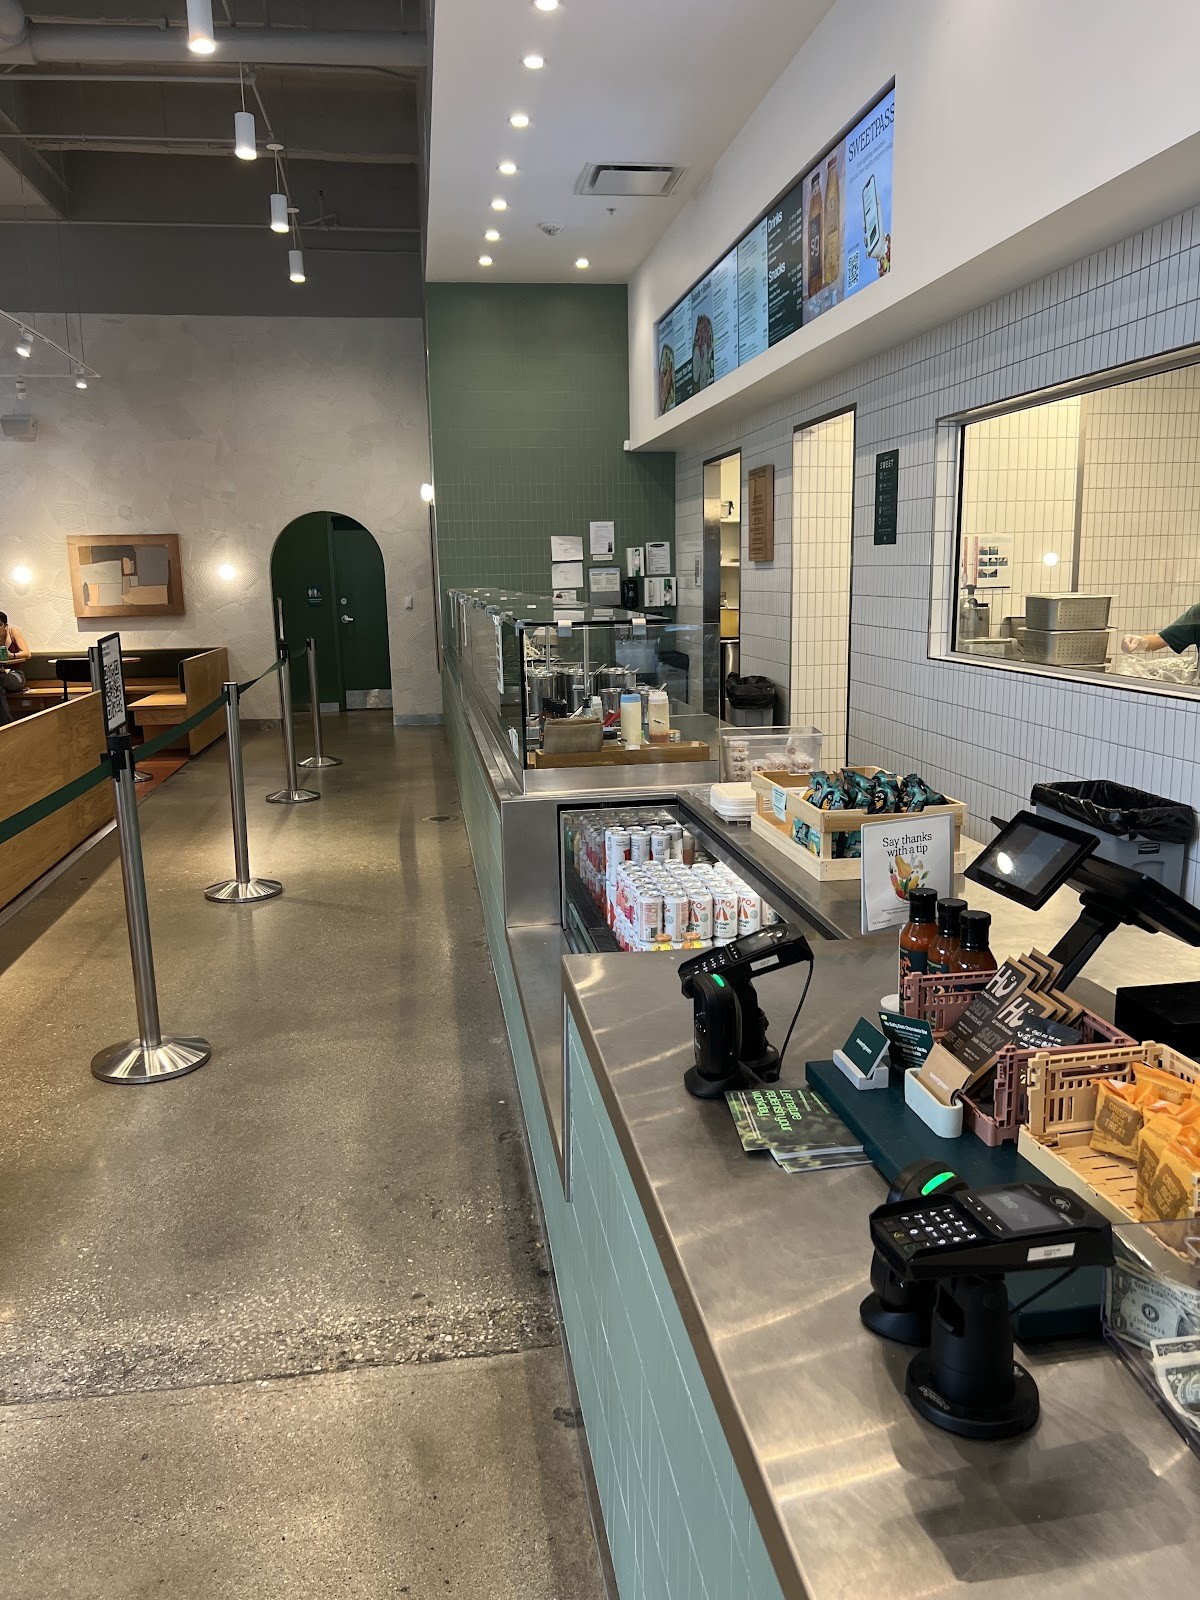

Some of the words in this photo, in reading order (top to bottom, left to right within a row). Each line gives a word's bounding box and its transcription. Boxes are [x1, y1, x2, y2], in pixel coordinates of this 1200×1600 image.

[848, 102, 895, 162] SWEETPASS
[768, 210, 783, 232] Drinks
[810, 235, 820, 257] sg
[768, 261, 786, 283] Snacks
[879, 459, 894, 470] SWEET
[882, 837, 900, 849] Say
[902, 832, 933, 845] thanks
[887, 845, 908, 858] with
[909, 846, 915, 854] a
[916, 843, 928, 855] tip
[752, 1090, 770, 1117] workday
[765, 1090, 786, 1117] replenish
[784, 1101, 802, 1120] nature
[1109, 1102, 1133, 1122] CRISPY
[775, 1116, 792, 1131] your
[1104, 1119, 1125, 1136] TREAT
[1110, 1114, 1125, 1126] RICE
